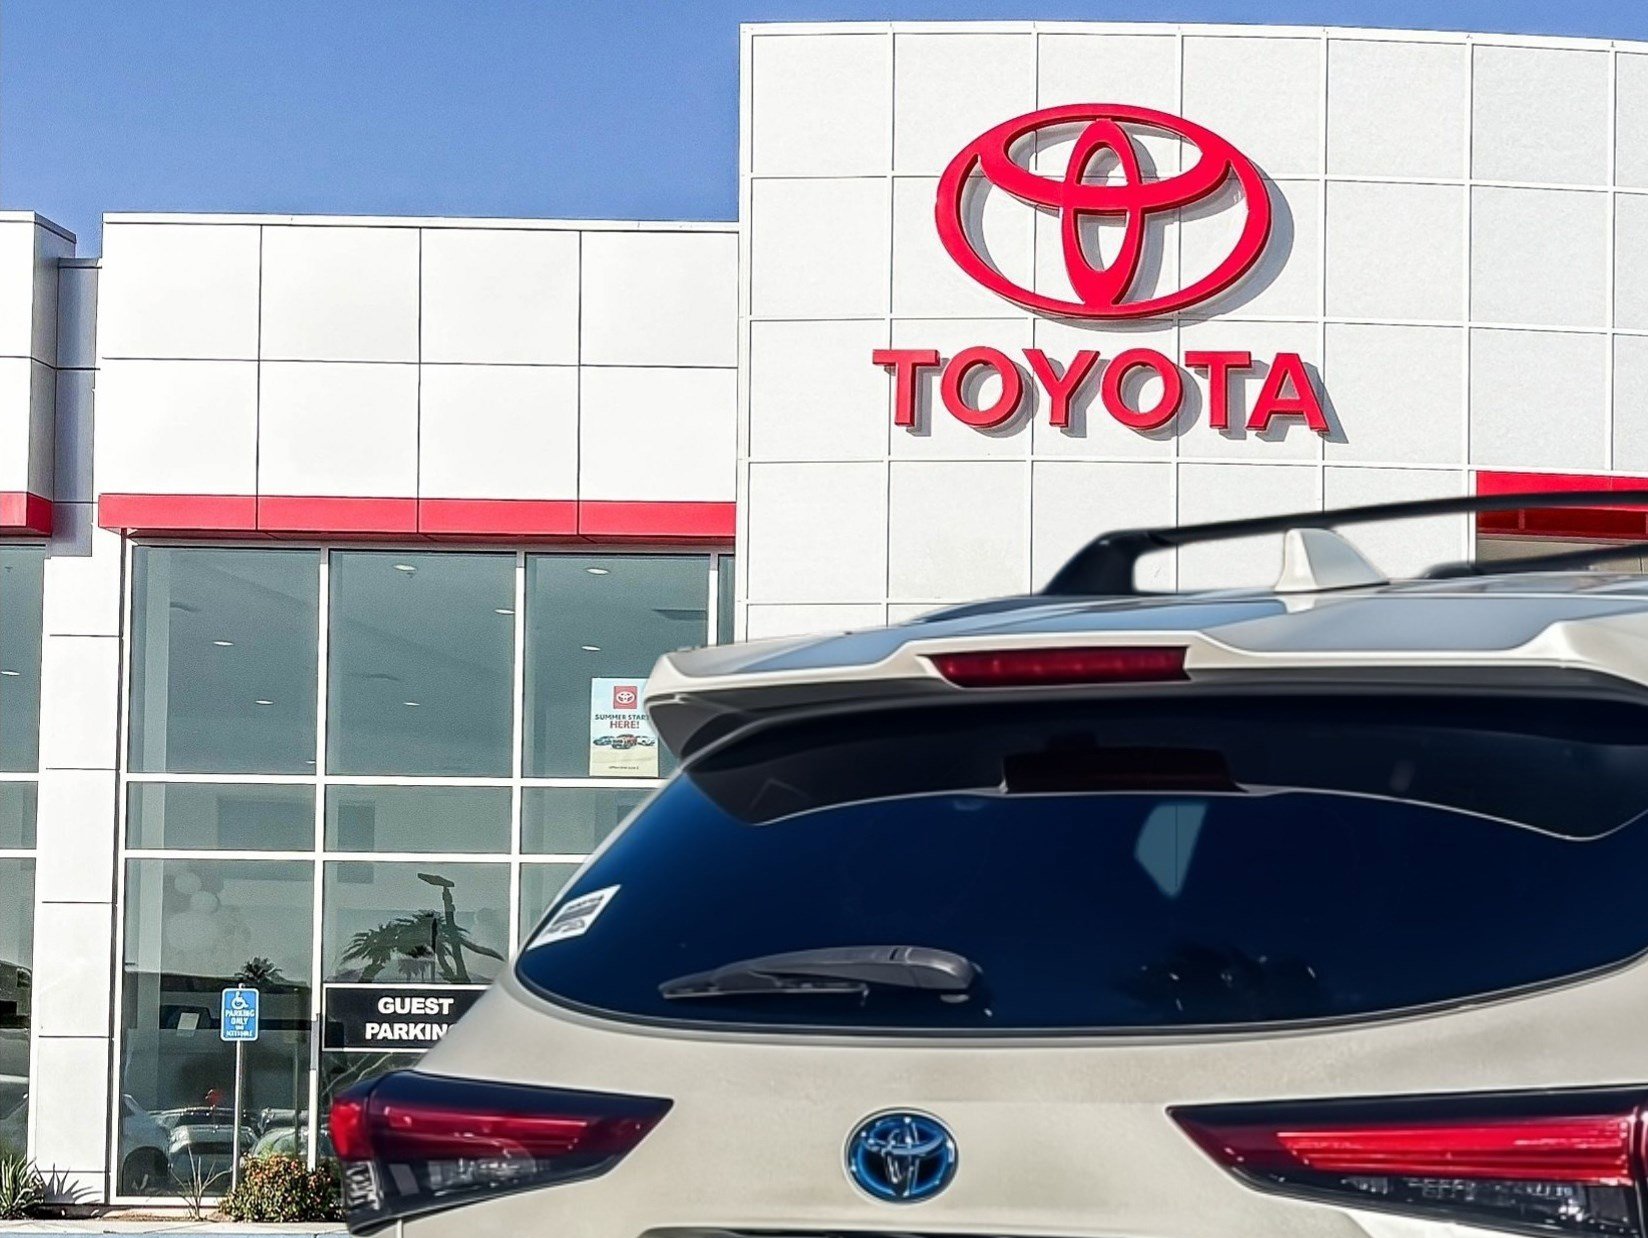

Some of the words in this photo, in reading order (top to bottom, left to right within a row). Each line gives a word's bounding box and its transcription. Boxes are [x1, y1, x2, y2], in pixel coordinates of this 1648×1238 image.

[872, 345, 1330, 433] TOYOTA
[609, 720, 640, 729] HERE!
[377, 997, 454, 1015] GUEST
[365, 1023, 453, 1040] PARKIN
